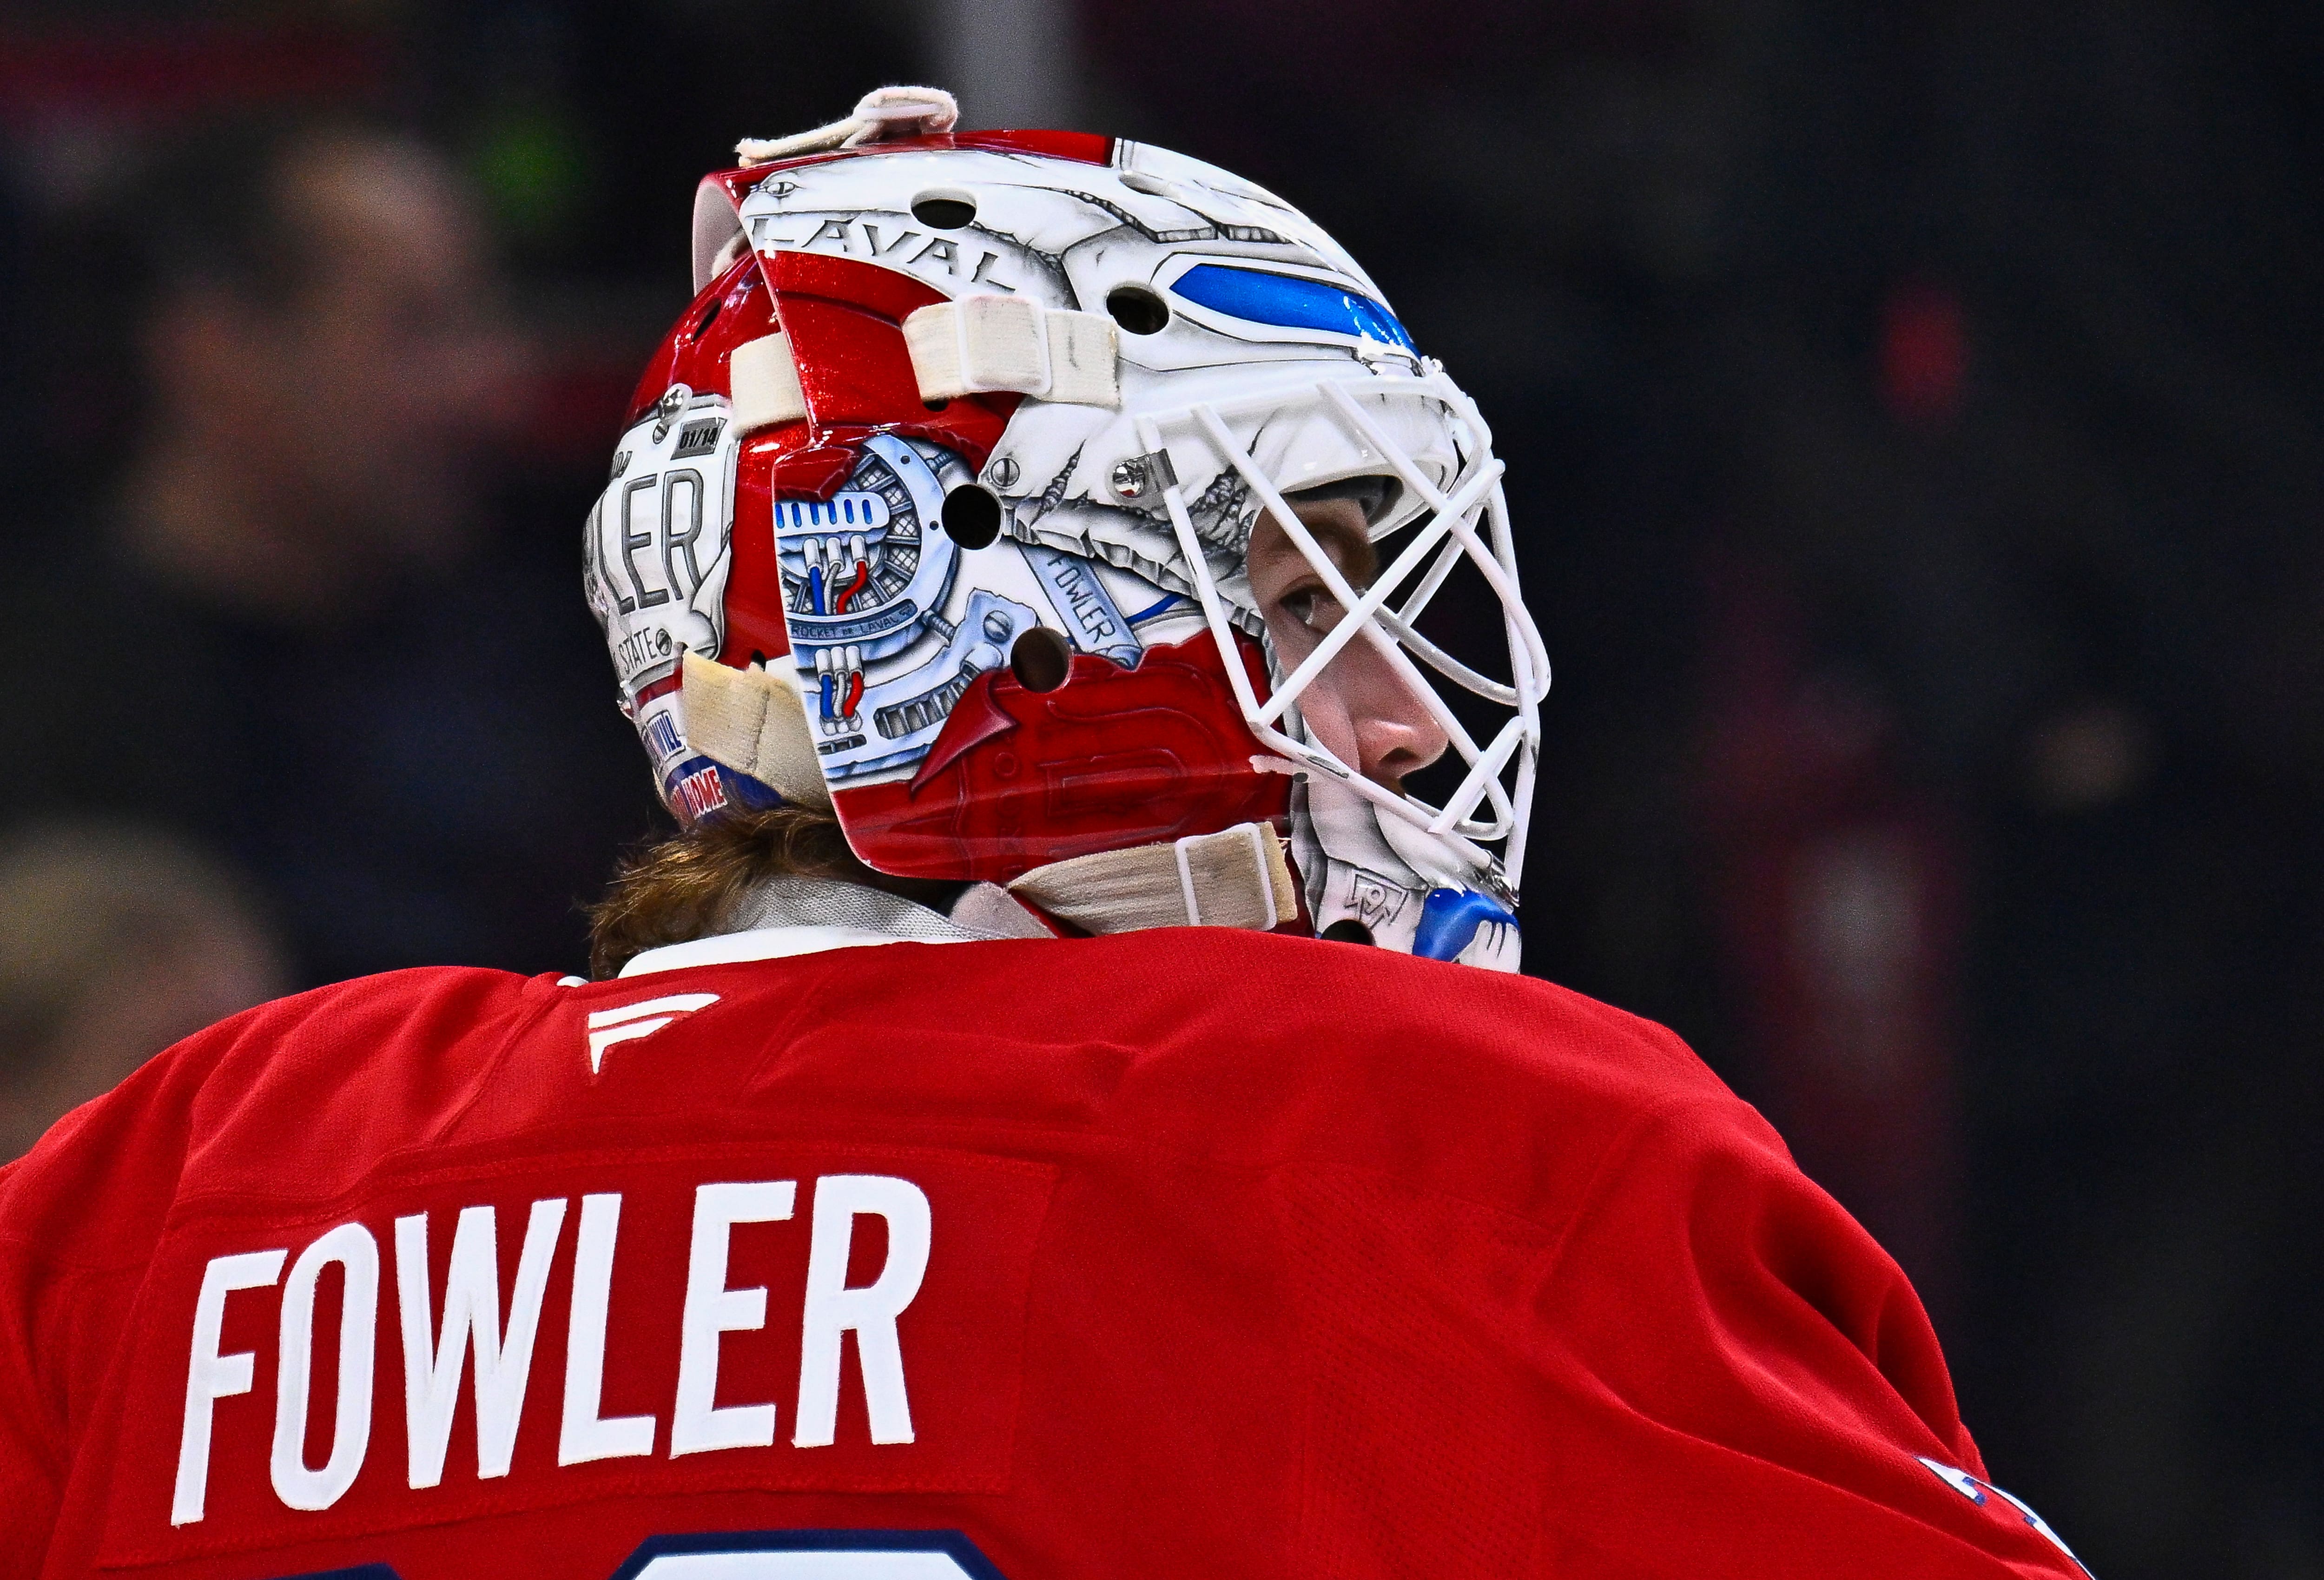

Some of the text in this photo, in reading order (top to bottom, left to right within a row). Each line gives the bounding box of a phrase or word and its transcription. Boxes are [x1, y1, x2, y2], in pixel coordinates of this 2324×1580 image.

[751, 217, 1016, 293] LAVAL
[679, 427, 718, 450] 01/14
[1047, 555, 1116, 644] FOWLER
[618, 627, 657, 674] STATE
[681, 766, 727, 820] HOME
[171, 1174, 931, 1529] FOWLER
